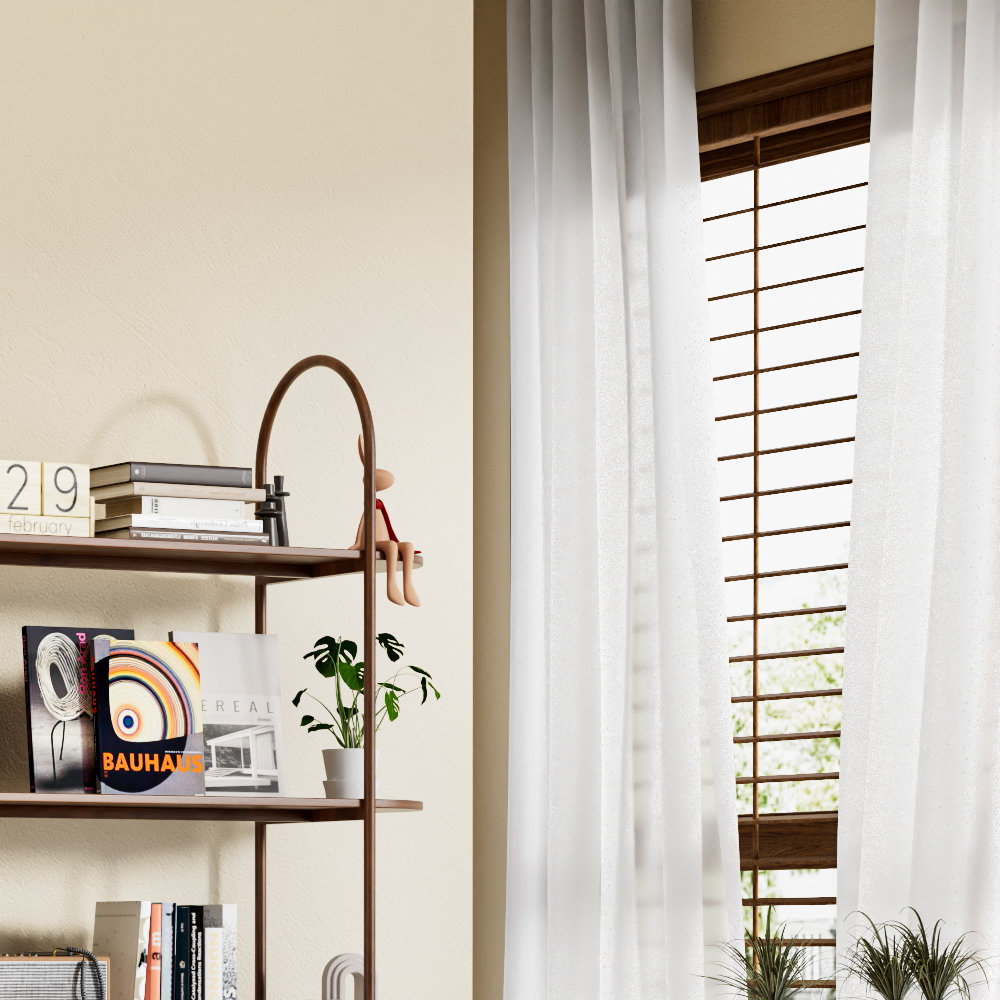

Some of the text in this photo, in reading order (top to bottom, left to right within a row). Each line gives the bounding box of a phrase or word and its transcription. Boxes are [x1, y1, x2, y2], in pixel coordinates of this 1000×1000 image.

[7, 515, 72, 536] february
[76, 632, 89, 694] Ron Arad
[90, 656, 98, 714] BAUHAUS
[200, 699, 274, 713] EREAL
[102, 751, 204, 774] BAUHAUS
